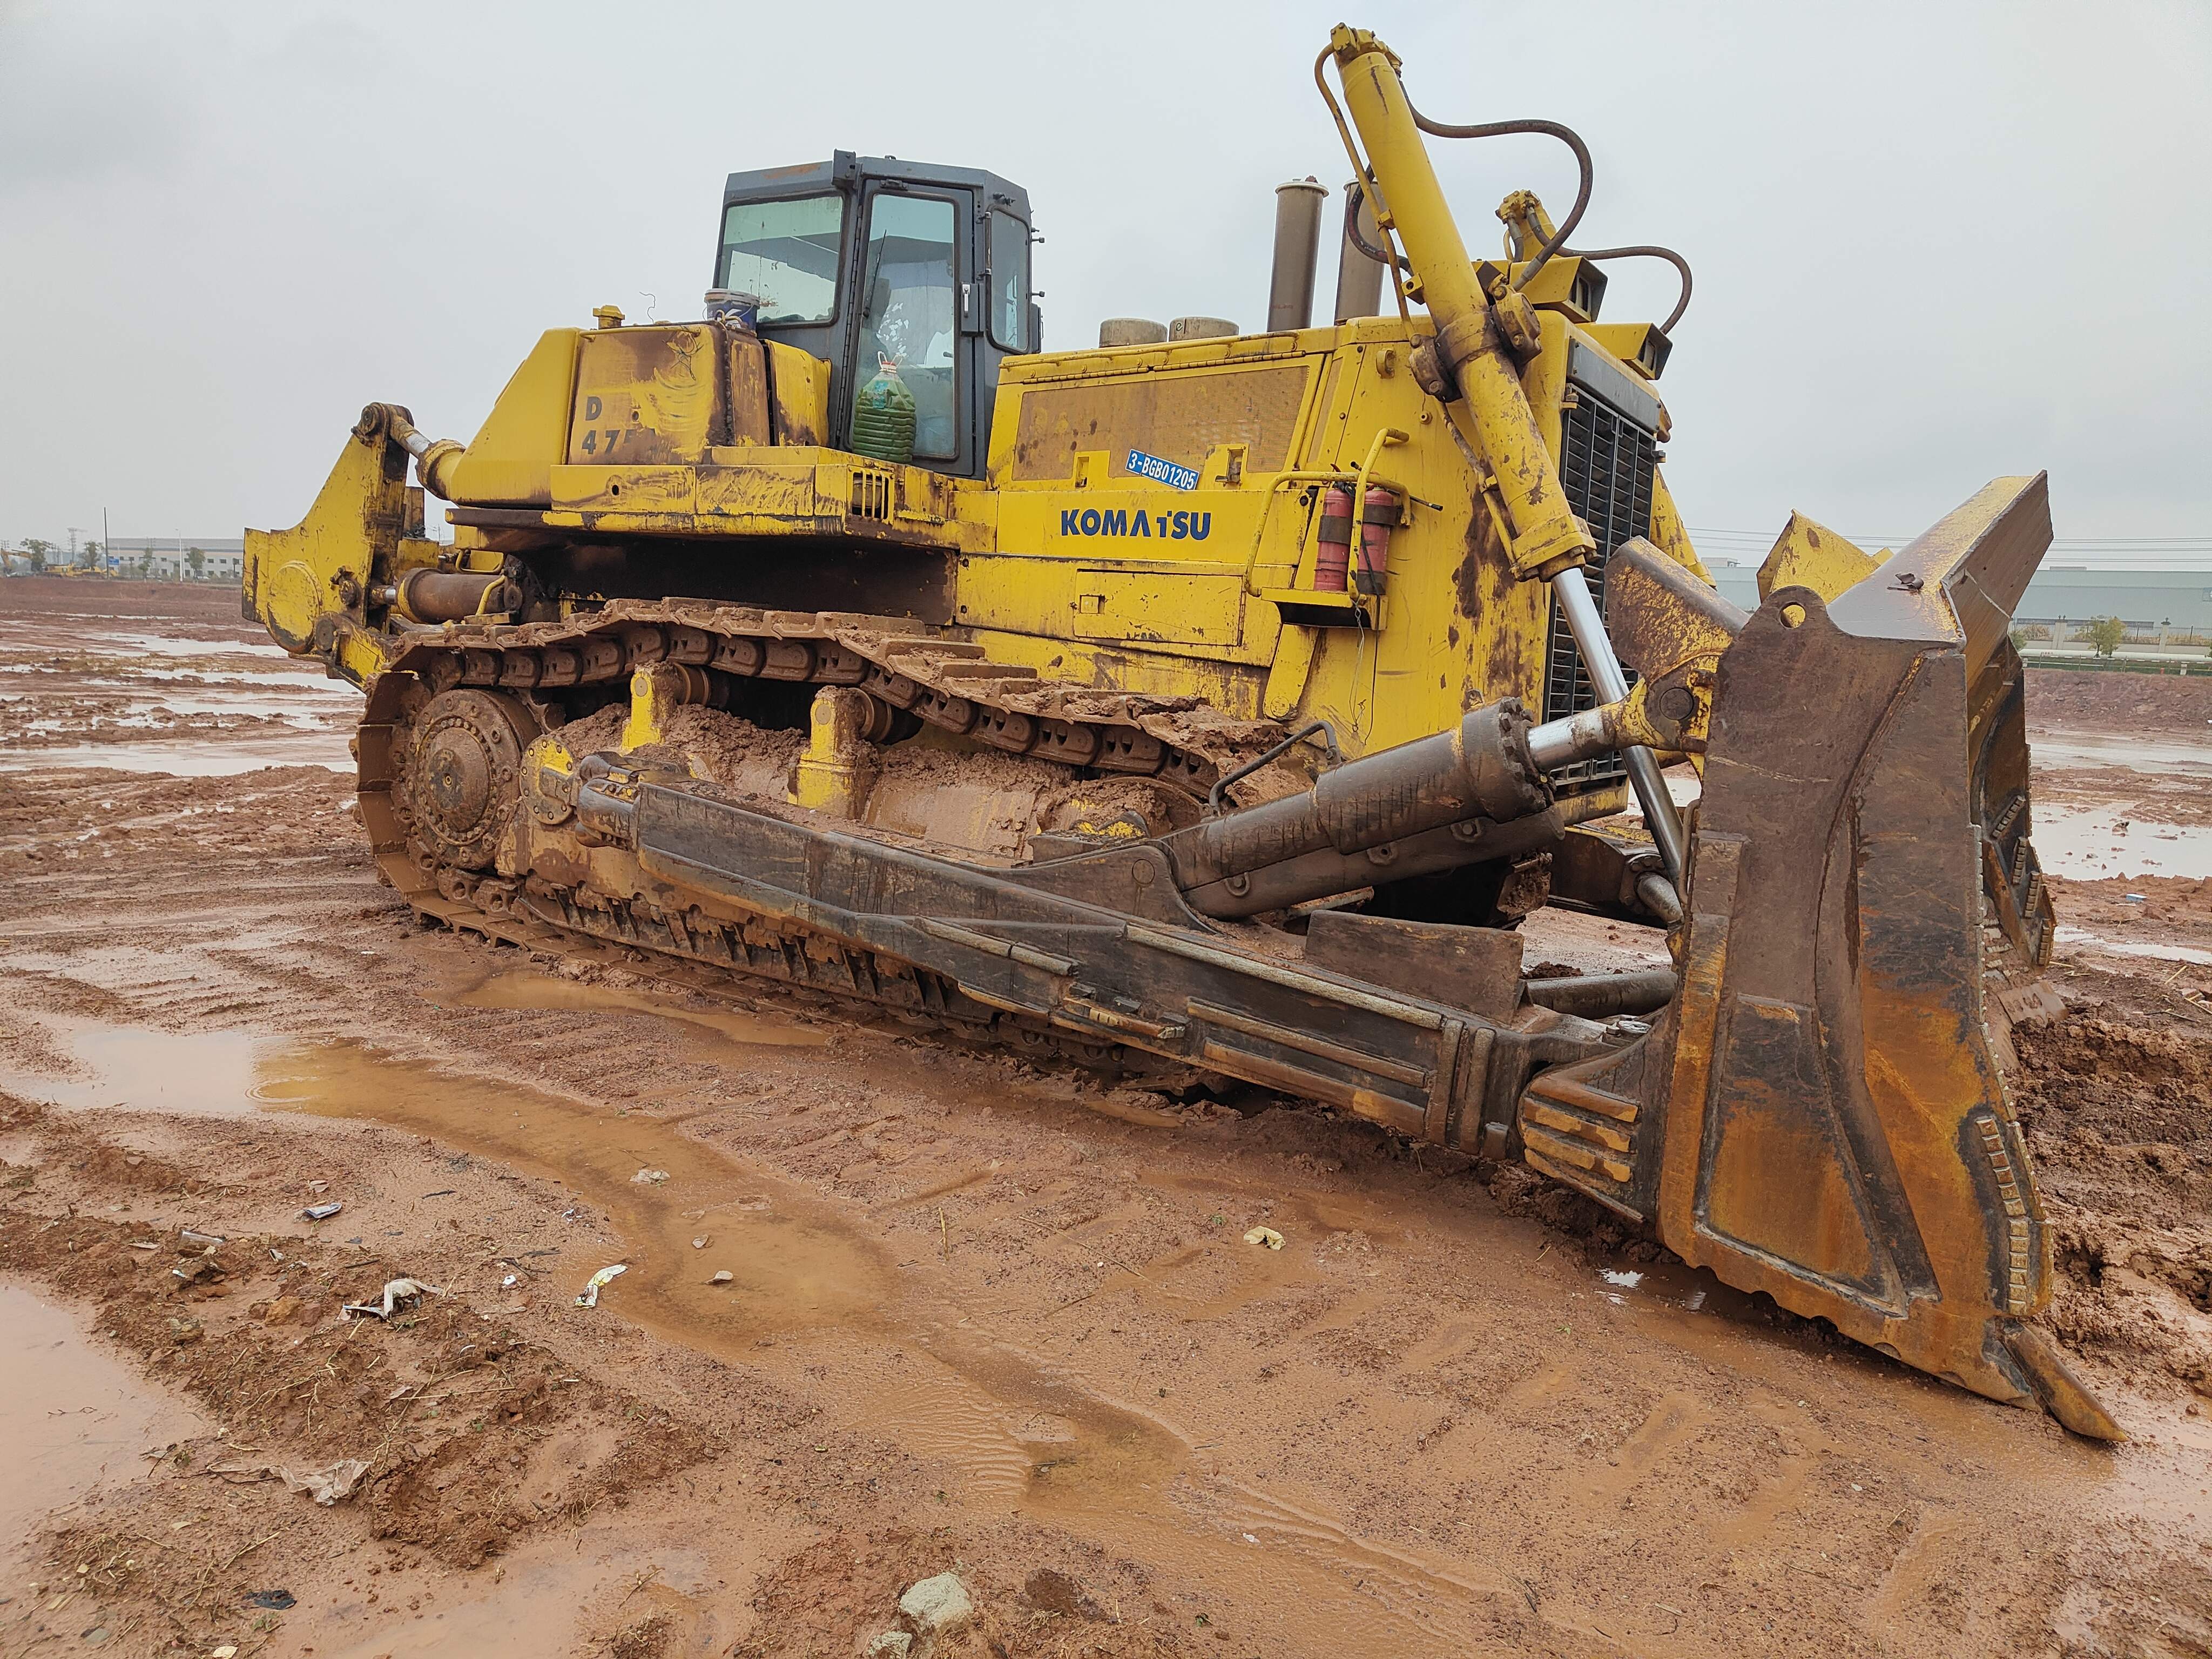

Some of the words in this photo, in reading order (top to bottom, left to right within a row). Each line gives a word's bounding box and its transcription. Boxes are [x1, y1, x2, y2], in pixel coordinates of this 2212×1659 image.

[585, 396, 603, 421] D
[582, 429, 638, 455] 47
[1129, 453, 1196, 489] 3-BGB01205
[1061, 509, 1211, 541] KOMATSU
